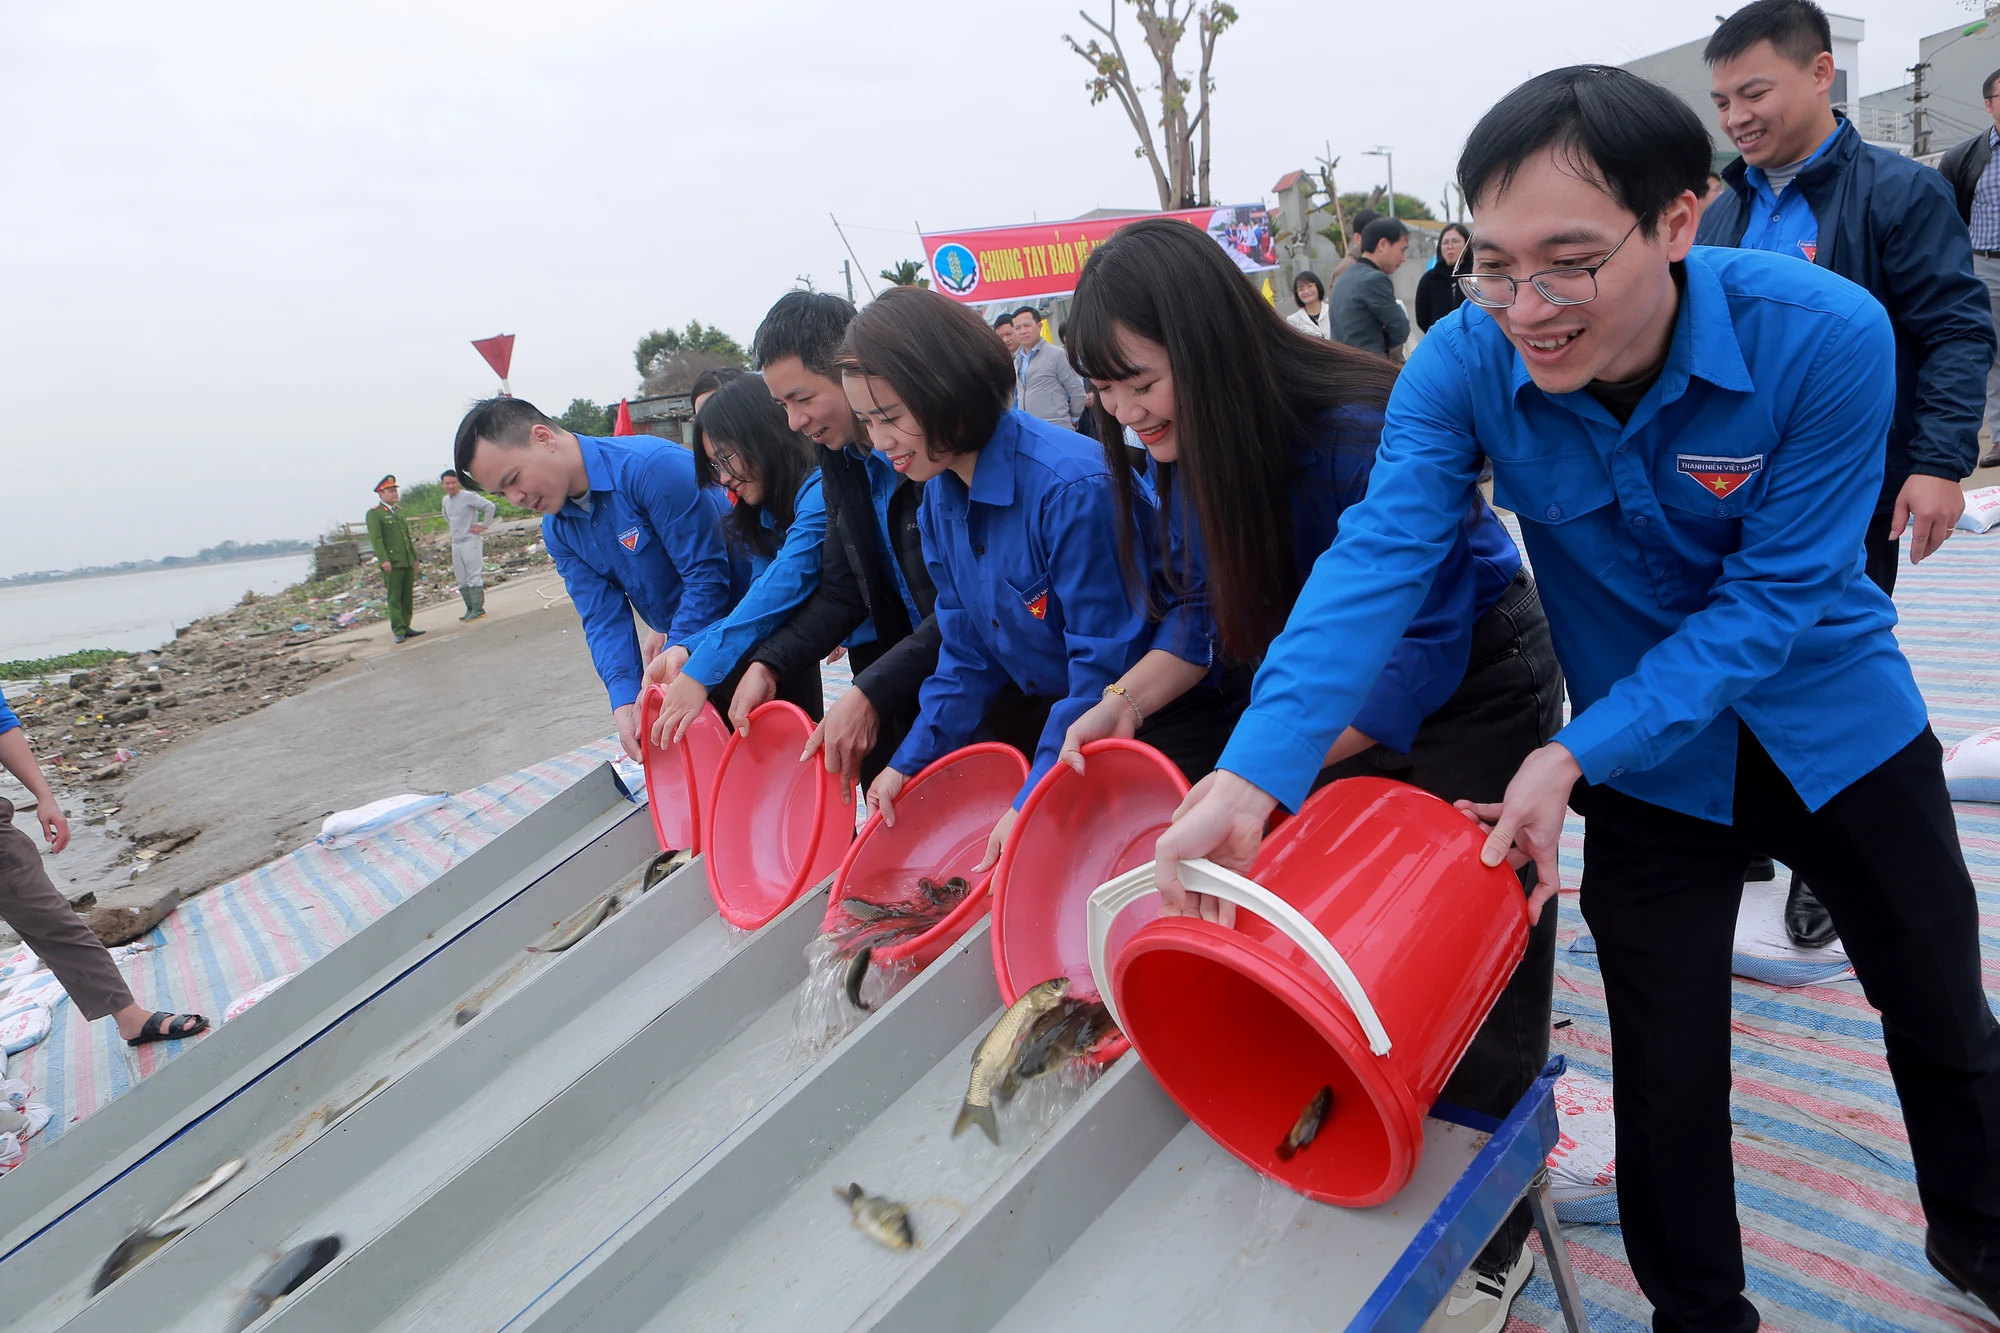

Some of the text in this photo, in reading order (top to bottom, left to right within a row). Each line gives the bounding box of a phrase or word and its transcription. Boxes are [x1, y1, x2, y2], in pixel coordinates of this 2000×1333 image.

[979, 248, 1024, 283] CHUNG
[1022, 245, 1048, 278] TAY
[1047, 230, 1075, 275] BẢO
[1681, 462, 1760, 472] THANH NIÊN VIỆT NAM
